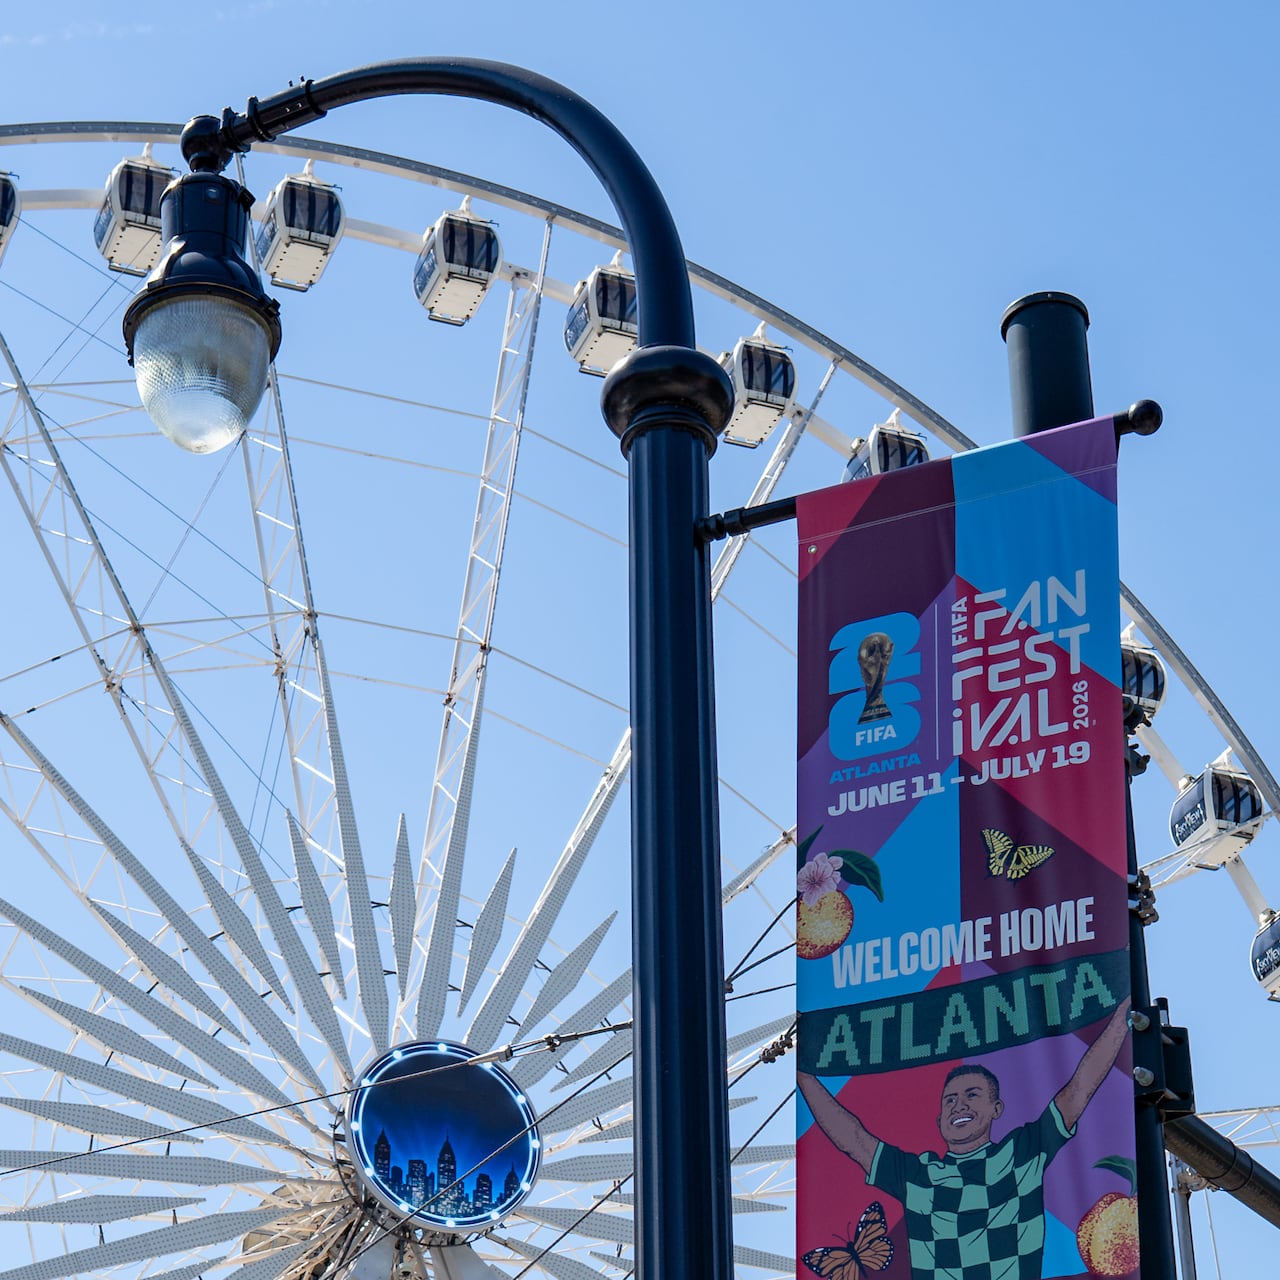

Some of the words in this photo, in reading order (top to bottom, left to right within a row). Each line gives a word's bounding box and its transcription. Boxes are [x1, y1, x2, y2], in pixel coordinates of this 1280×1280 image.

[951, 596, 968, 647] FIFA
[974, 569, 1086, 641] FAN
[952, 623, 1090, 700] FEST
[855, 724, 897, 746] FIFA
[1072, 680, 1088, 729] 2026
[827, 778, 907, 817] JUNE
[911, 772, 945, 798] 11
[970, 748, 1046, 786] JULY
[1052, 741, 1091, 766] 19
[828, 752, 921, 785] ATLANTA
[831, 916, 992, 989] WELCOME
[999, 896, 1095, 957] HOME
[816, 961, 1116, 1068] ATLANTA
